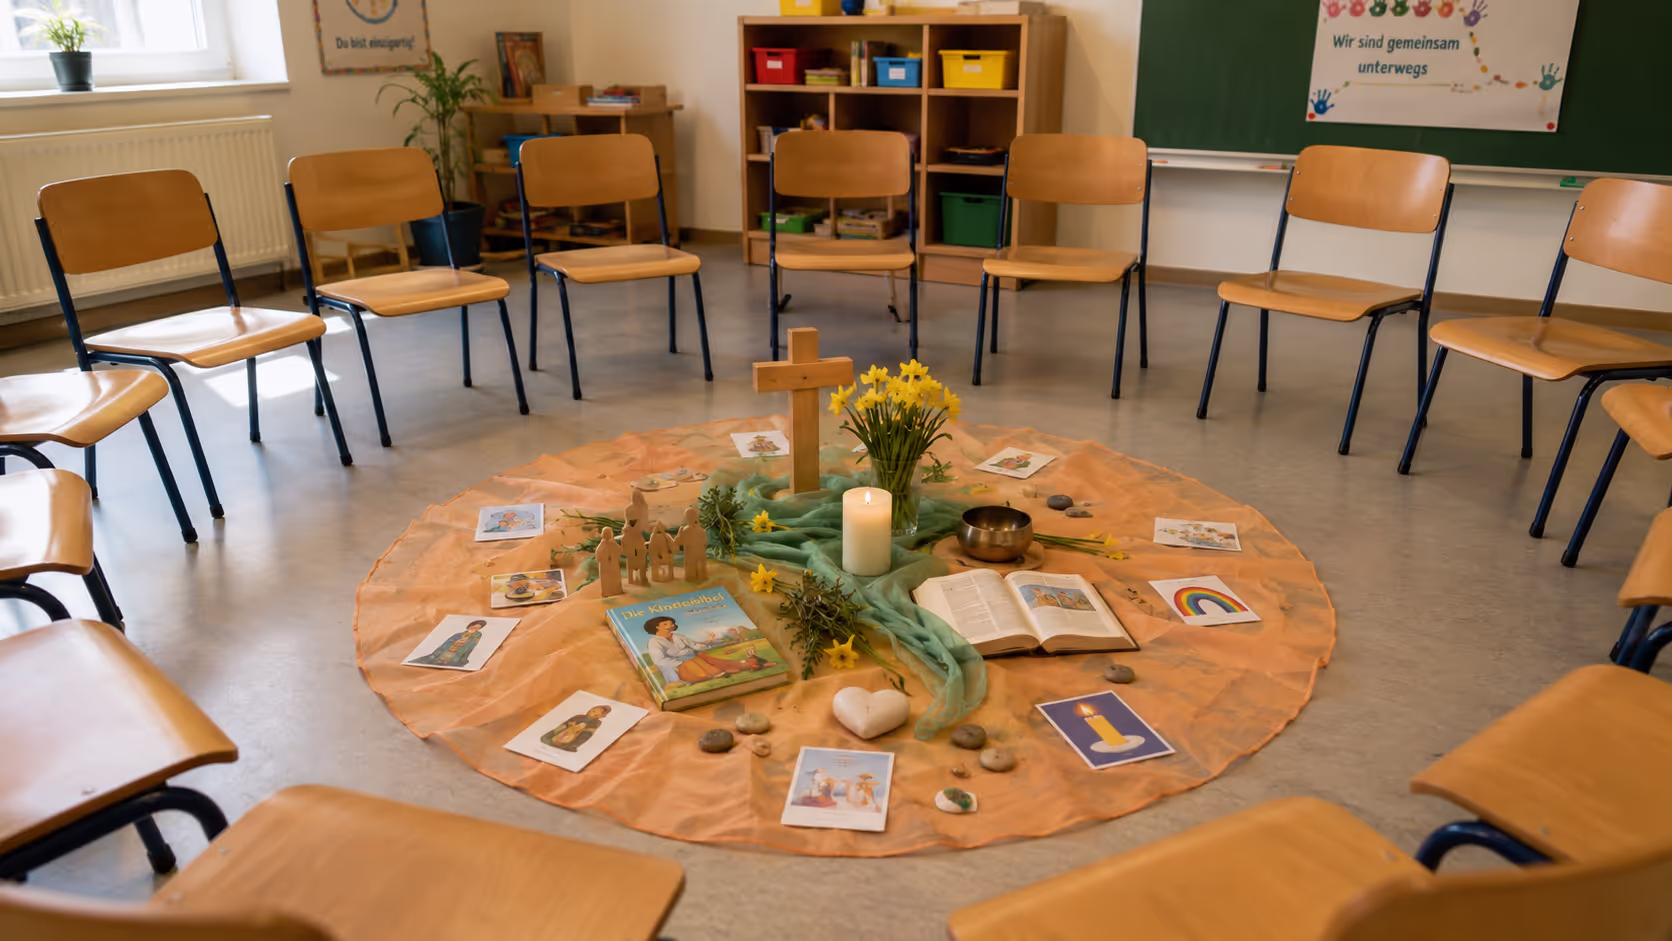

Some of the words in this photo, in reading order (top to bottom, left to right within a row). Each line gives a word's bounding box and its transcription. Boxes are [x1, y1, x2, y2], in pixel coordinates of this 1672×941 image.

[335, 36, 349, 49] Du
[350, 35, 367, 49] bist
[369, 34, 415, 52] einzigartig!
[1333, 34, 1356, 49] Wir
[1358, 34, 1384, 49] sind
[1386, 35, 1460, 54] gemeinsam
[1358, 60, 1429, 79] unterwegs
[621, 609, 646, 621] Die
